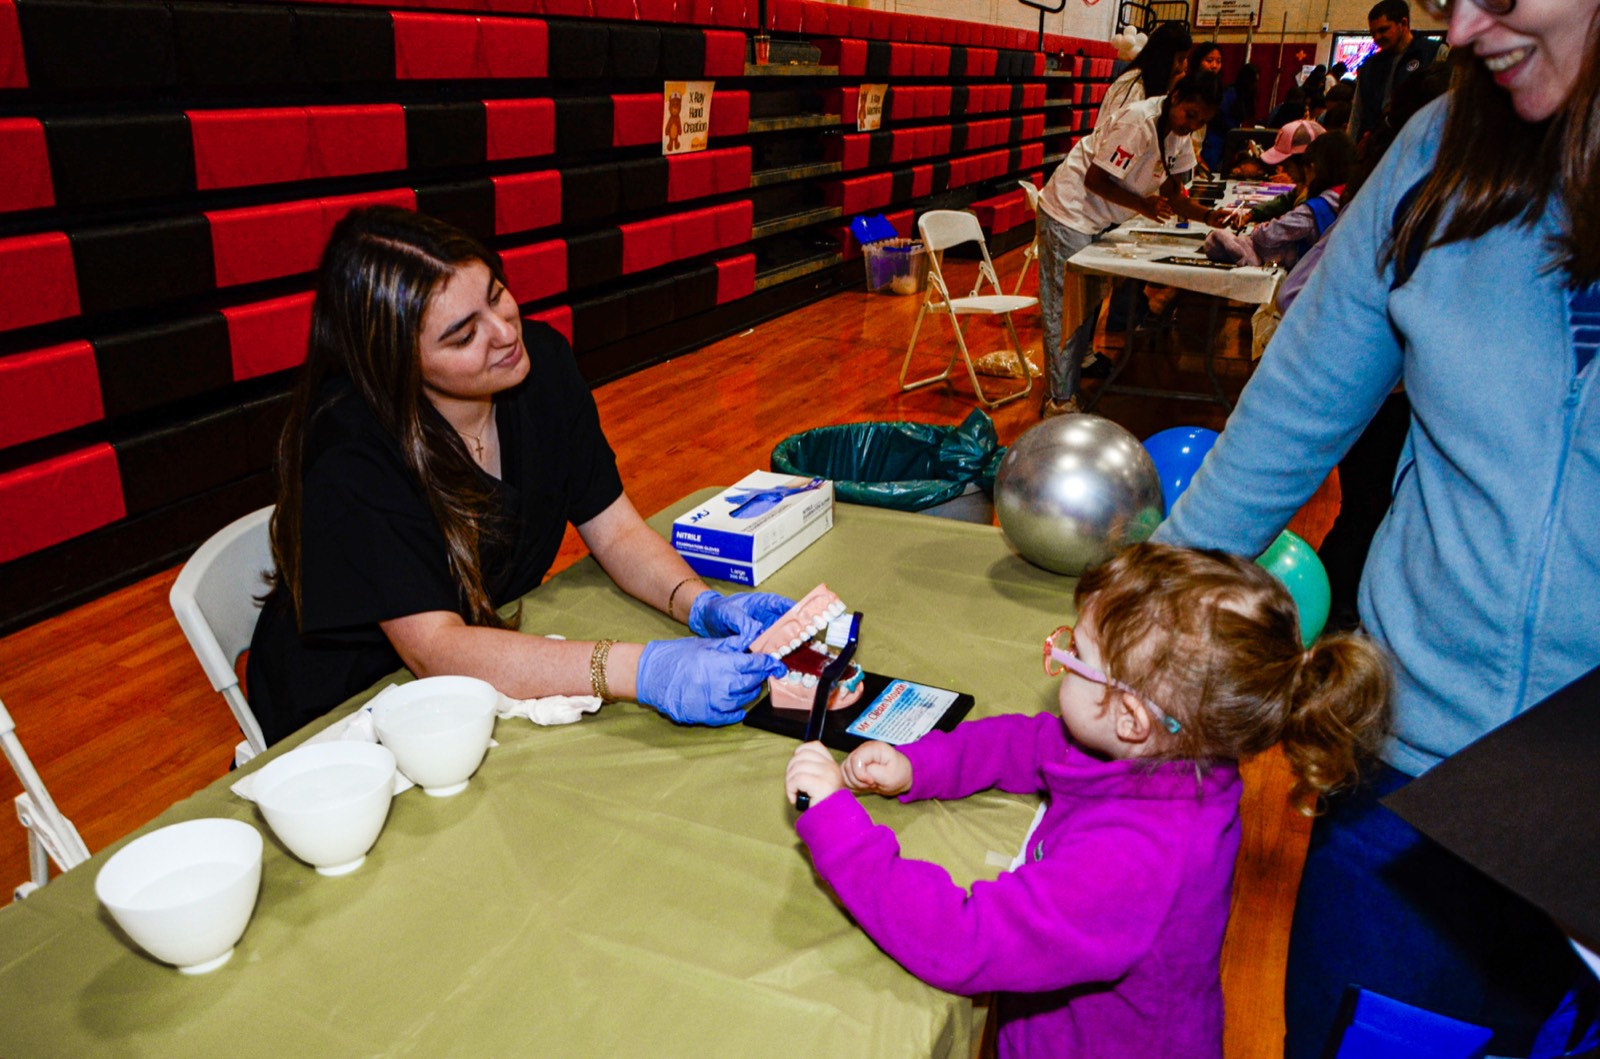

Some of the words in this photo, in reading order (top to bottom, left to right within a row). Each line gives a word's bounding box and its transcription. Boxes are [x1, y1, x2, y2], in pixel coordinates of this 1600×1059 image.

[689, 92, 694, 103] X
[694, 92, 705, 105] Ray
[689, 107, 703, 118] Hand
[683, 121, 707, 134] Creation
[676, 531, 701, 543] NITRILE
[868, 702, 888, 721] Clean
[885, 683, 907, 705] Mouth
